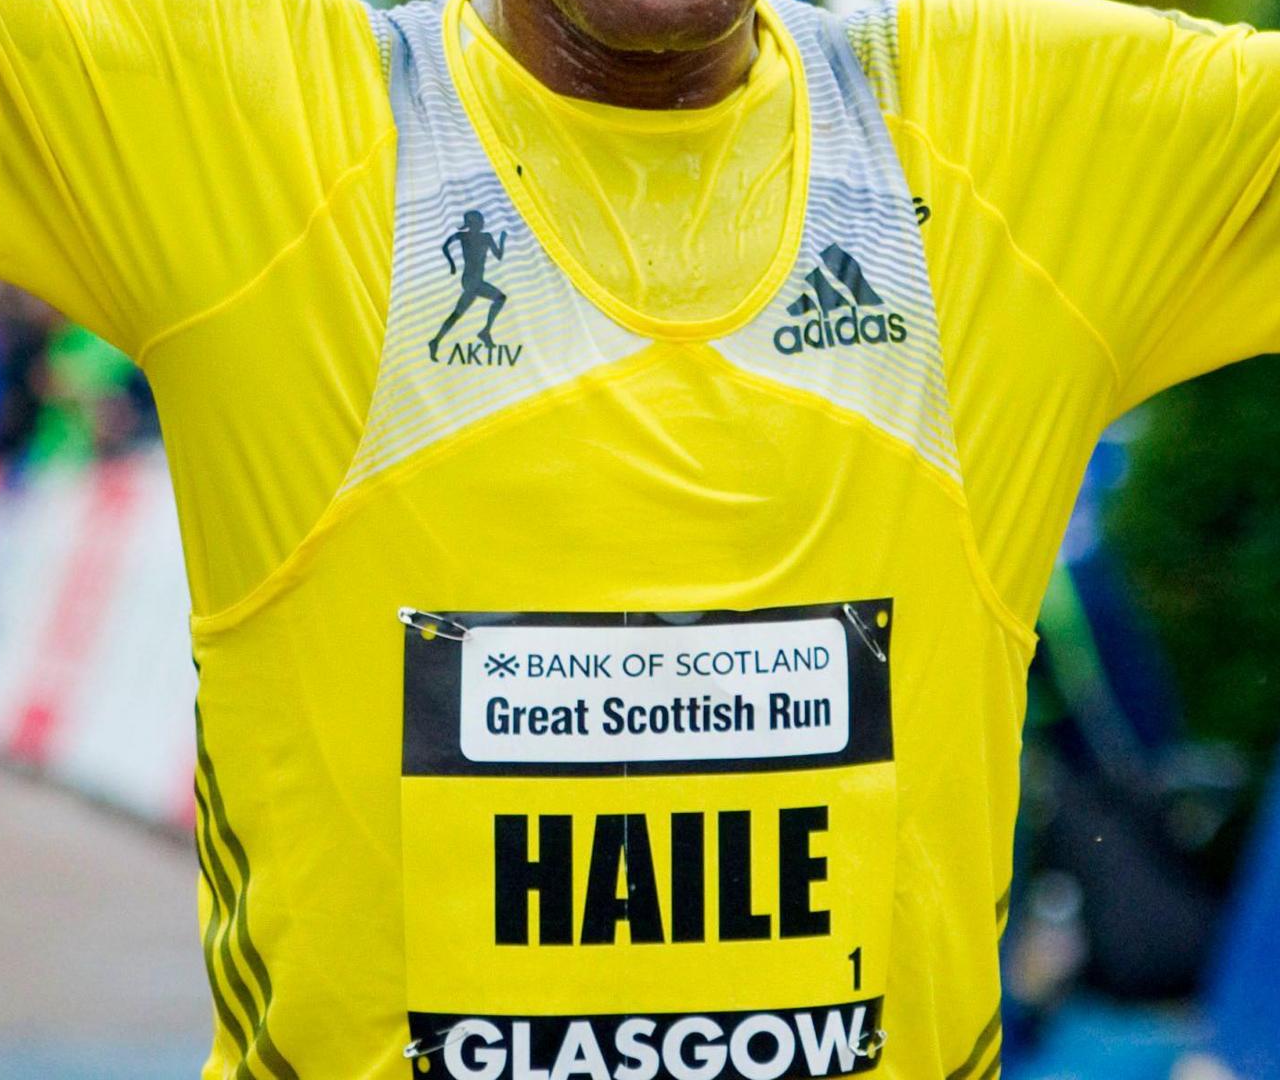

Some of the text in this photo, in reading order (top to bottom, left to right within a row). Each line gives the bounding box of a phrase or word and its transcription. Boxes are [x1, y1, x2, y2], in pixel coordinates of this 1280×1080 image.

[773, 305, 908, 356] adidas
[447, 343, 523, 367] AKTIV
[527, 646, 831, 679] BANK OF SCOTLAND
[485, 692, 832, 736] Great Scottish Run
[493, 805, 831, 946] HAILE
[847, 946, 863, 992] 1
[442, 1005, 868, 1080] GLASGOW
